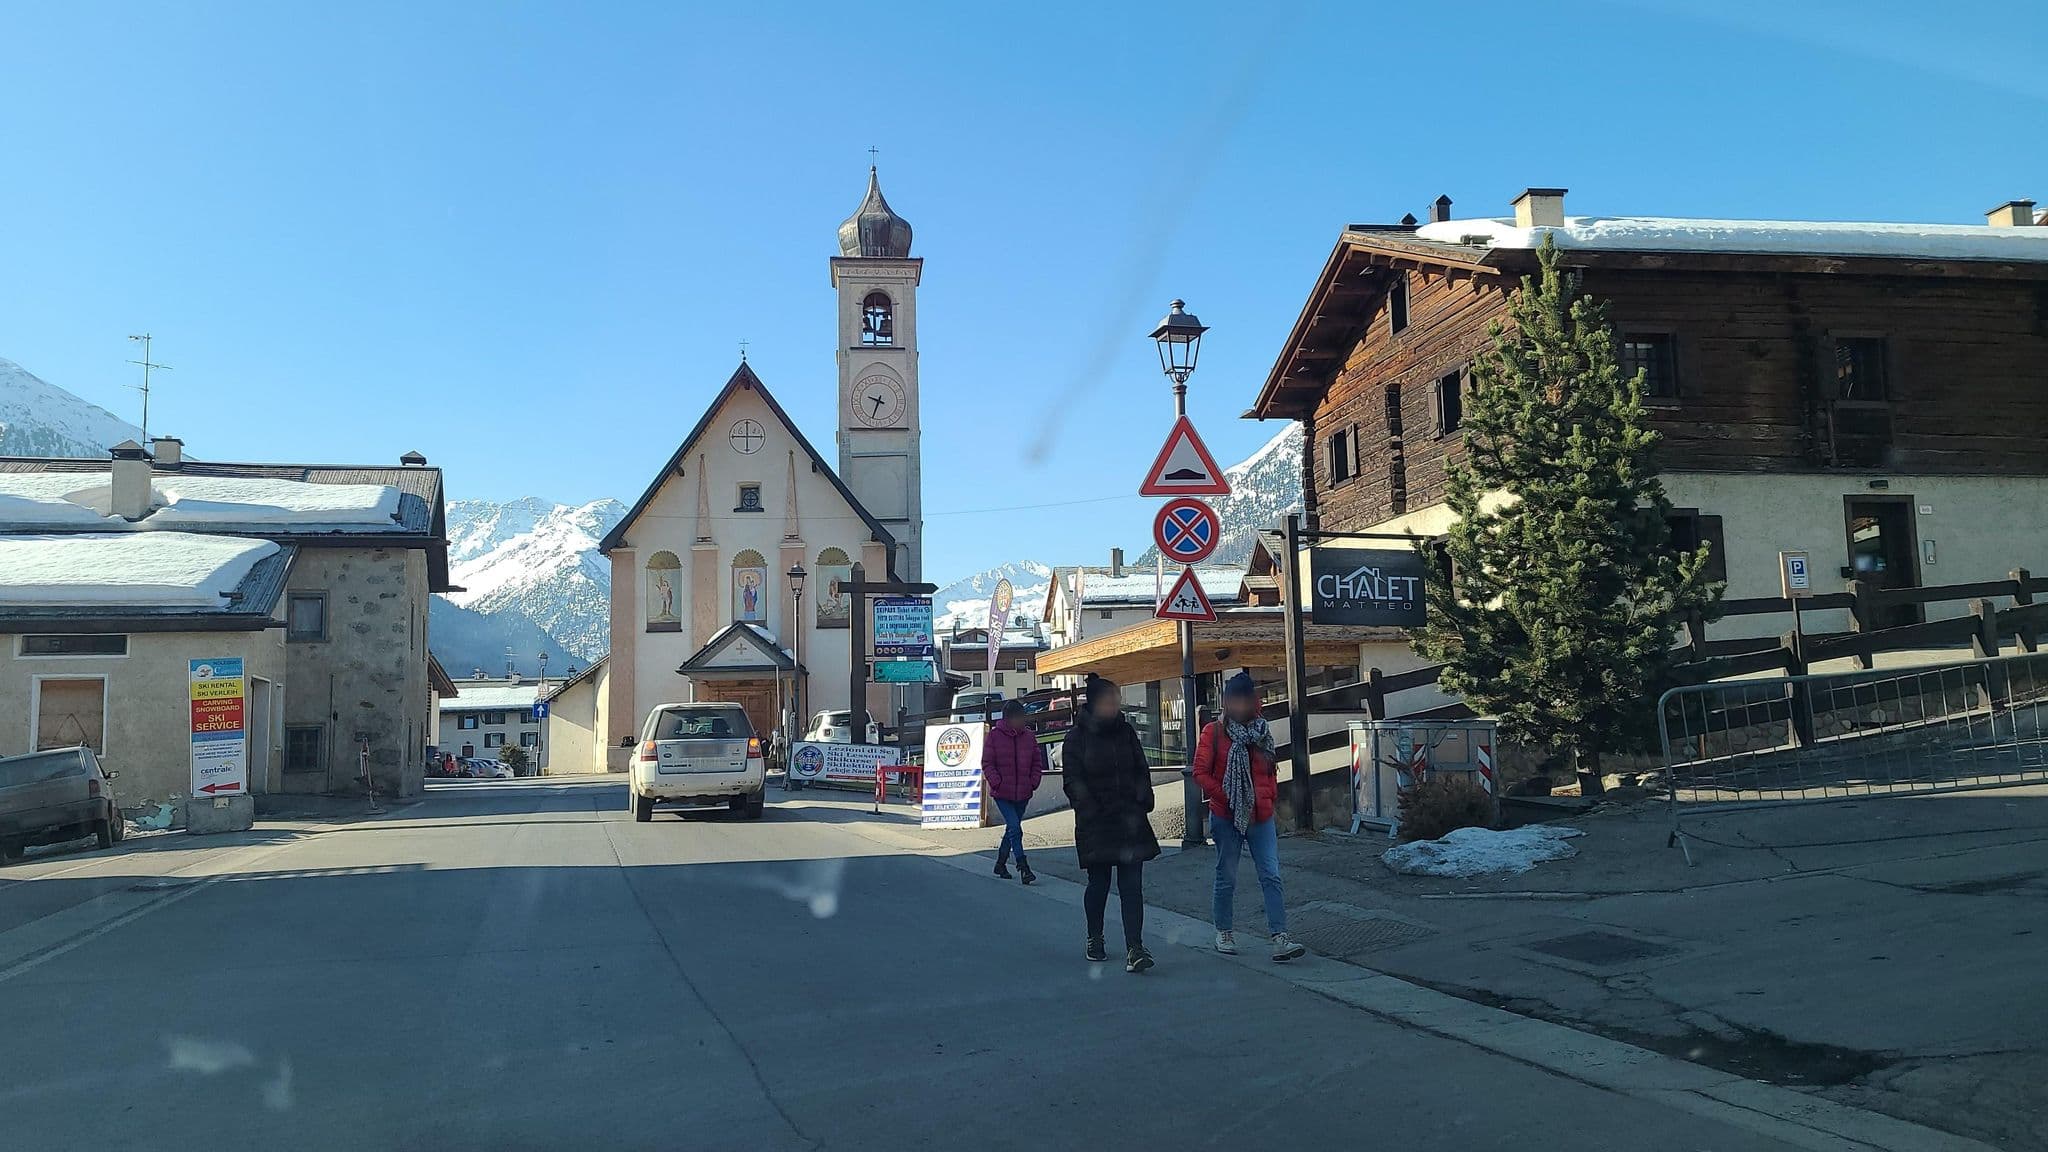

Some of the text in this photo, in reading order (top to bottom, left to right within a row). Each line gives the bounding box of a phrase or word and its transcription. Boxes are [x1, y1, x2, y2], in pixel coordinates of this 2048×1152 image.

[1793, 561, 1802, 574] P
[1317, 574, 1419, 601] CHALET
[1324, 601, 1412, 610] MATTEO
[990, 614, 999, 637] SKI
[208, 714, 225, 722] SKI
[196, 720, 240, 731] SERVICE
